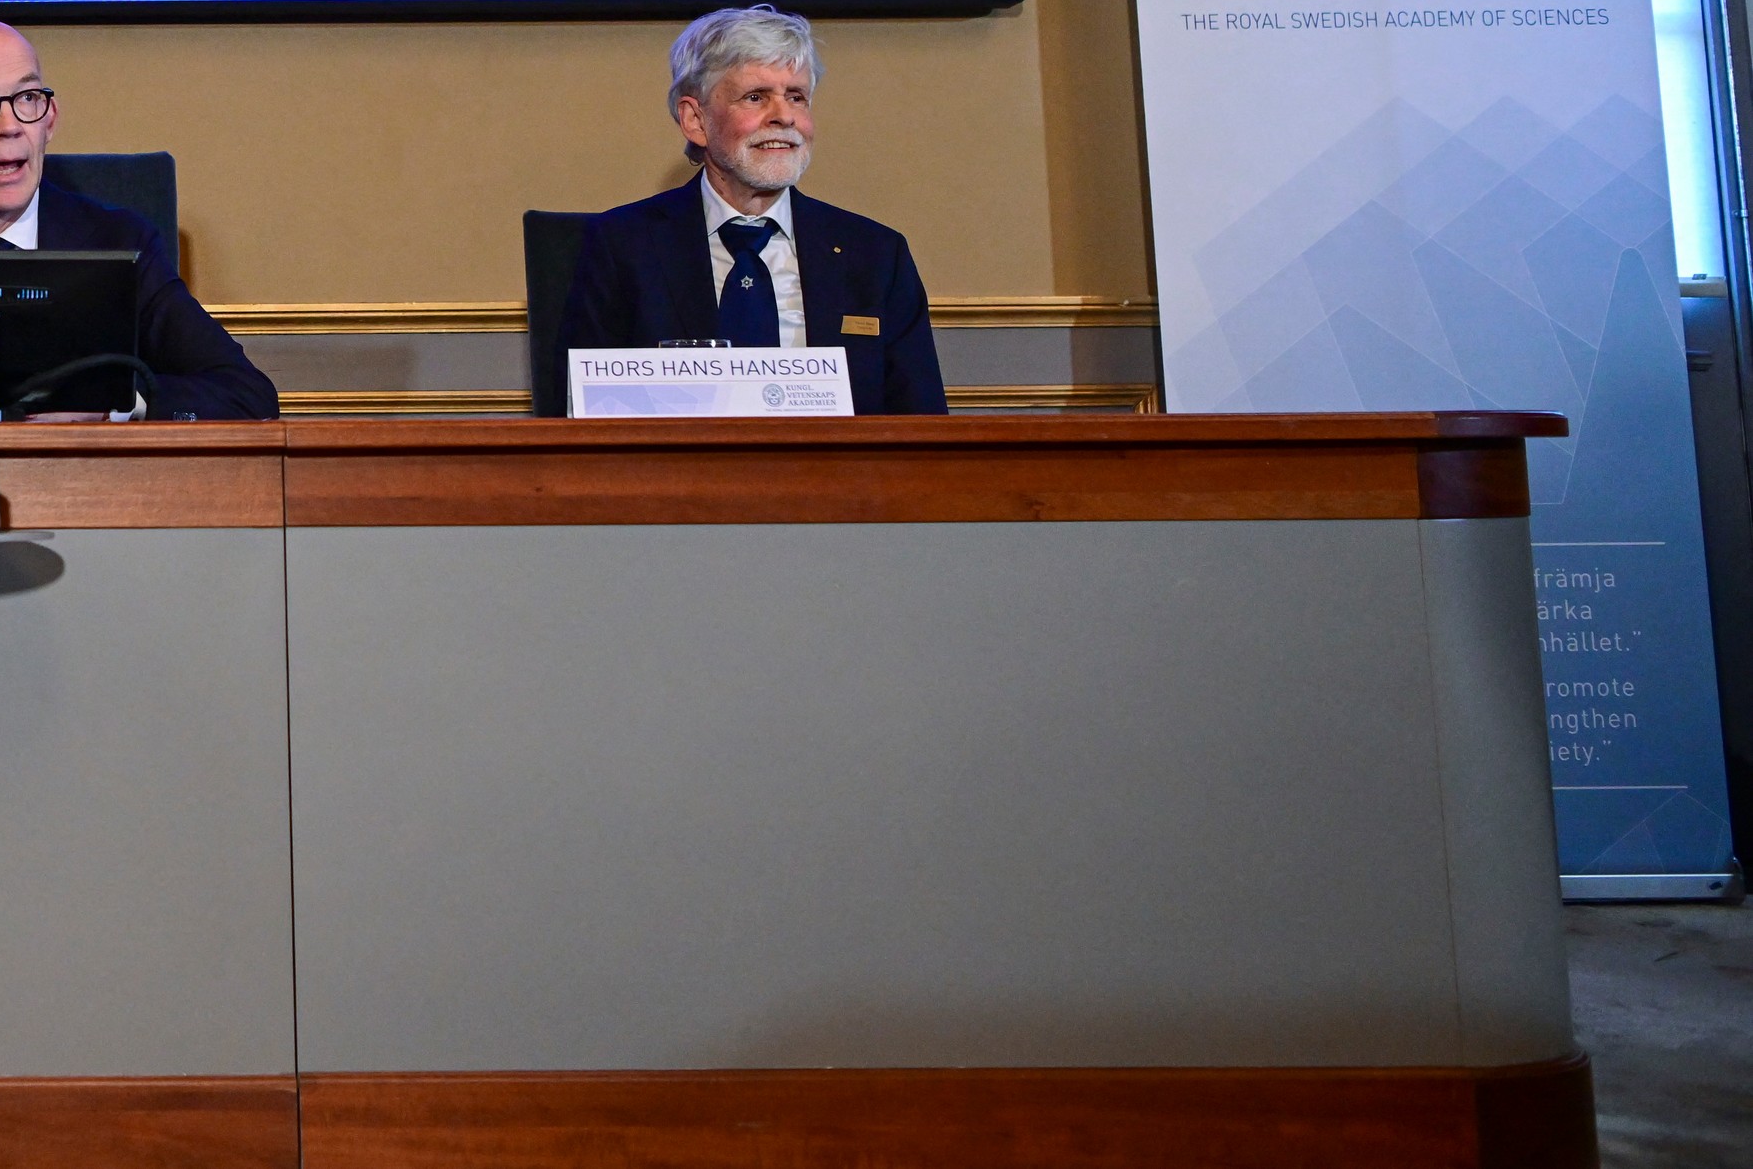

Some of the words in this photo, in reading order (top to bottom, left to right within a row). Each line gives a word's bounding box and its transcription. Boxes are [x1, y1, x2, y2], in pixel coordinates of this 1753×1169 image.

[1182, 14, 1219, 30] THE
[1226, 13, 1285, 29] ROYAL
[1291, 12, 1379, 28] SWEDISH
[1384, 10, 1476, 27] ACADEMY
[1482, 10, 1506, 26] OF
[1512, 8, 1610, 25] SCIENCES
[581, 360, 654, 377] THORS
[662, 360, 723, 376] HANS
[730, 359, 838, 376] HANSSON
[1533, 567, 1615, 592] främja
[1537, 599, 1592, 620] ärka
[1546, 678, 1635, 697] romote
[1551, 708, 1637, 734] ngthen
[1550, 740, 1611, 766] iety.”
